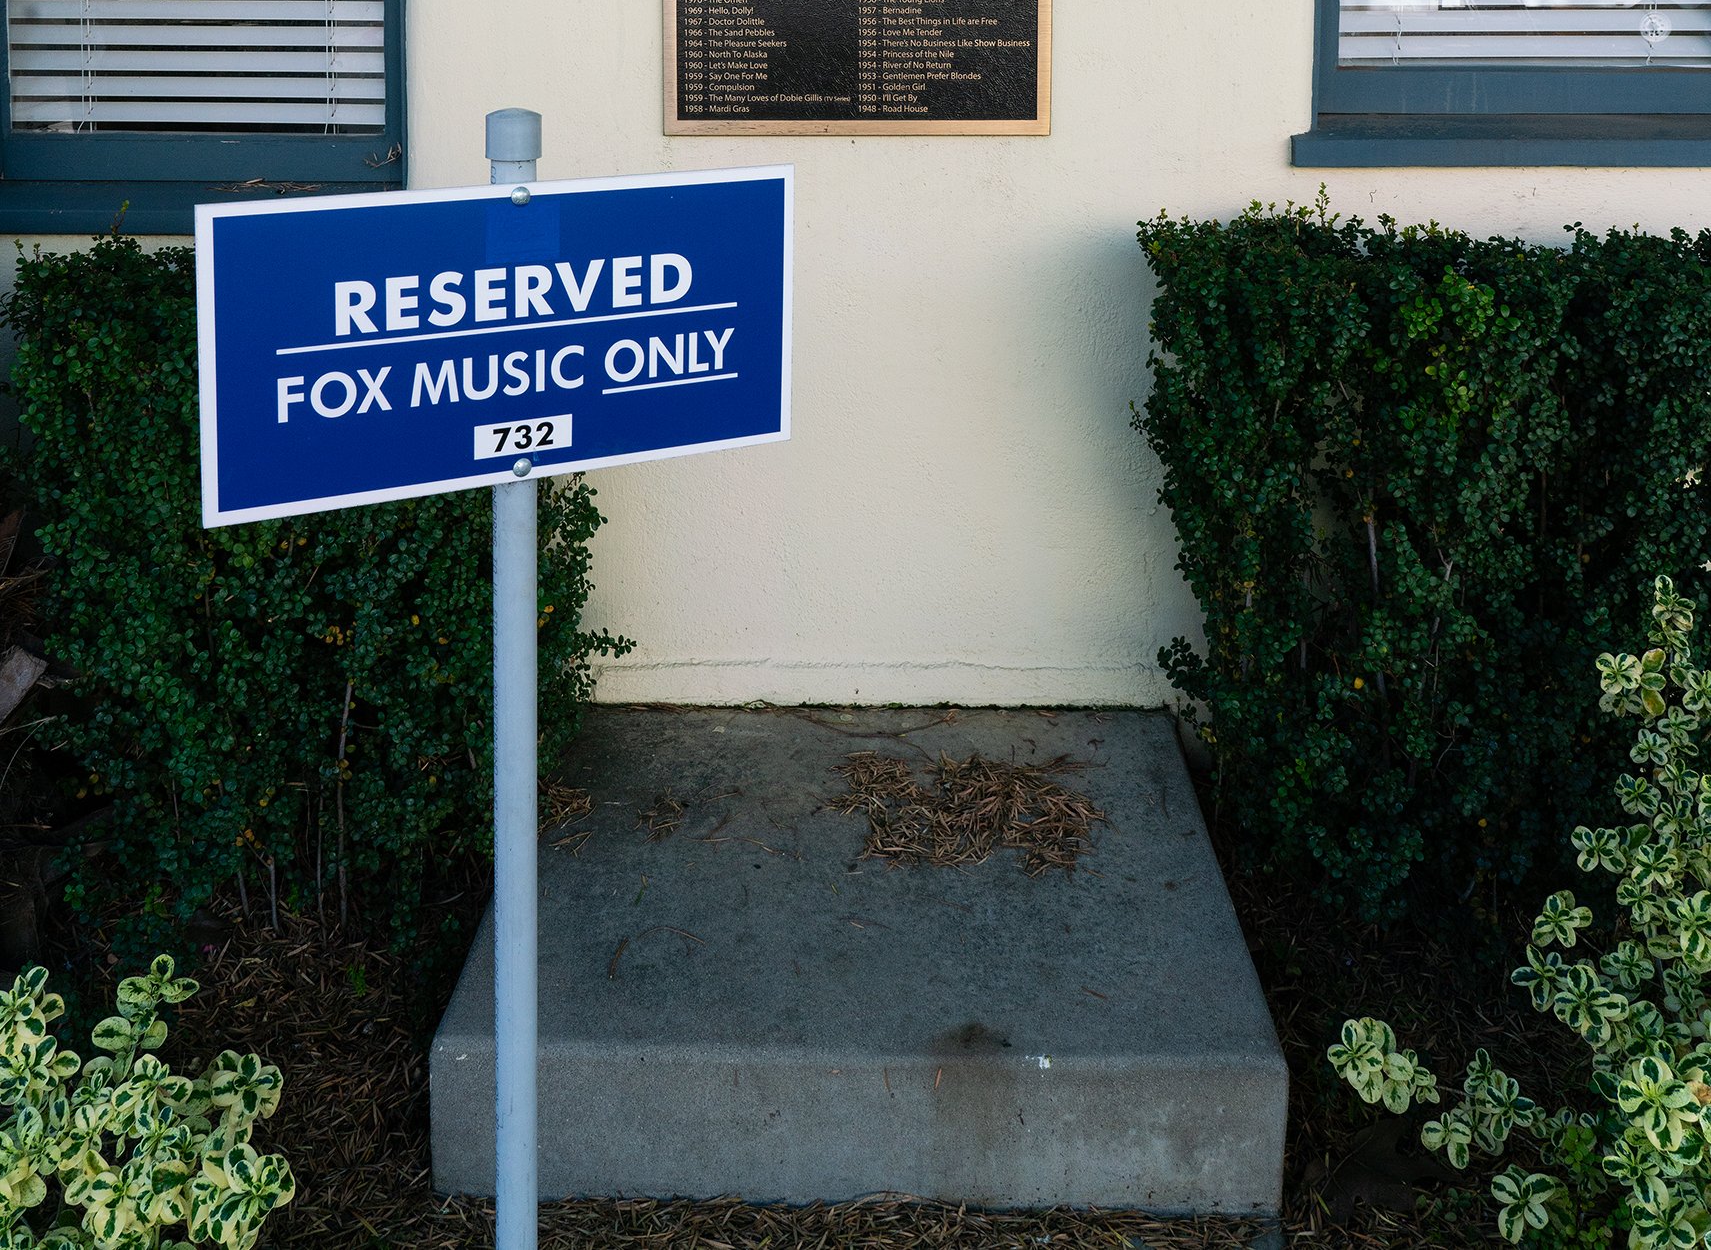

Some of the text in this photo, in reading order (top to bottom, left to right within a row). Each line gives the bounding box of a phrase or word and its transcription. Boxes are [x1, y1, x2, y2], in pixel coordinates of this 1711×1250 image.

[684, 18, 702, 26] 1967
[708, 18, 735, 26] Doctor
[736, 18, 764, 26] Dolittle
[684, 29, 702, 37] 1966
[708, 29, 722, 37] The
[724, 29, 743, 37] Sand
[744, 29, 775, 37] Pebbles
[858, 39, 876, 47] 1954
[909, 39, 921, 47] No
[922, 39, 956, 47] Business
[957, 39, 973, 47] Like
[974, 39, 996, 47] Show
[997, 39, 1030, 47] Business
[684, 50, 703, 58] 1960
[708, 50, 731, 58] North
[732, 50, 741, 58] To
[742, 50, 767, 58] Alaska
[858, 61, 876, 69] 1954
[882, 61, 902, 69] River
[902, 61, 911, 69] of
[912, 61, 924, 69] No
[925, 61, 951, 69] Return
[858, 72, 876, 80] 1953
[882, 72, 925, 80] Gentlemen
[926, 72, 949, 80] Prefer
[950, 72, 981, 80] Blondes
[858, 105, 876, 113] 1948
[882, 105, 902, 113] Road
[903, 105, 928, 113] House
[335, 252, 693, 336] RESERVED
[277, 327, 735, 423] FOX MUSIC ONLY
[492, 421, 555, 452] 732
